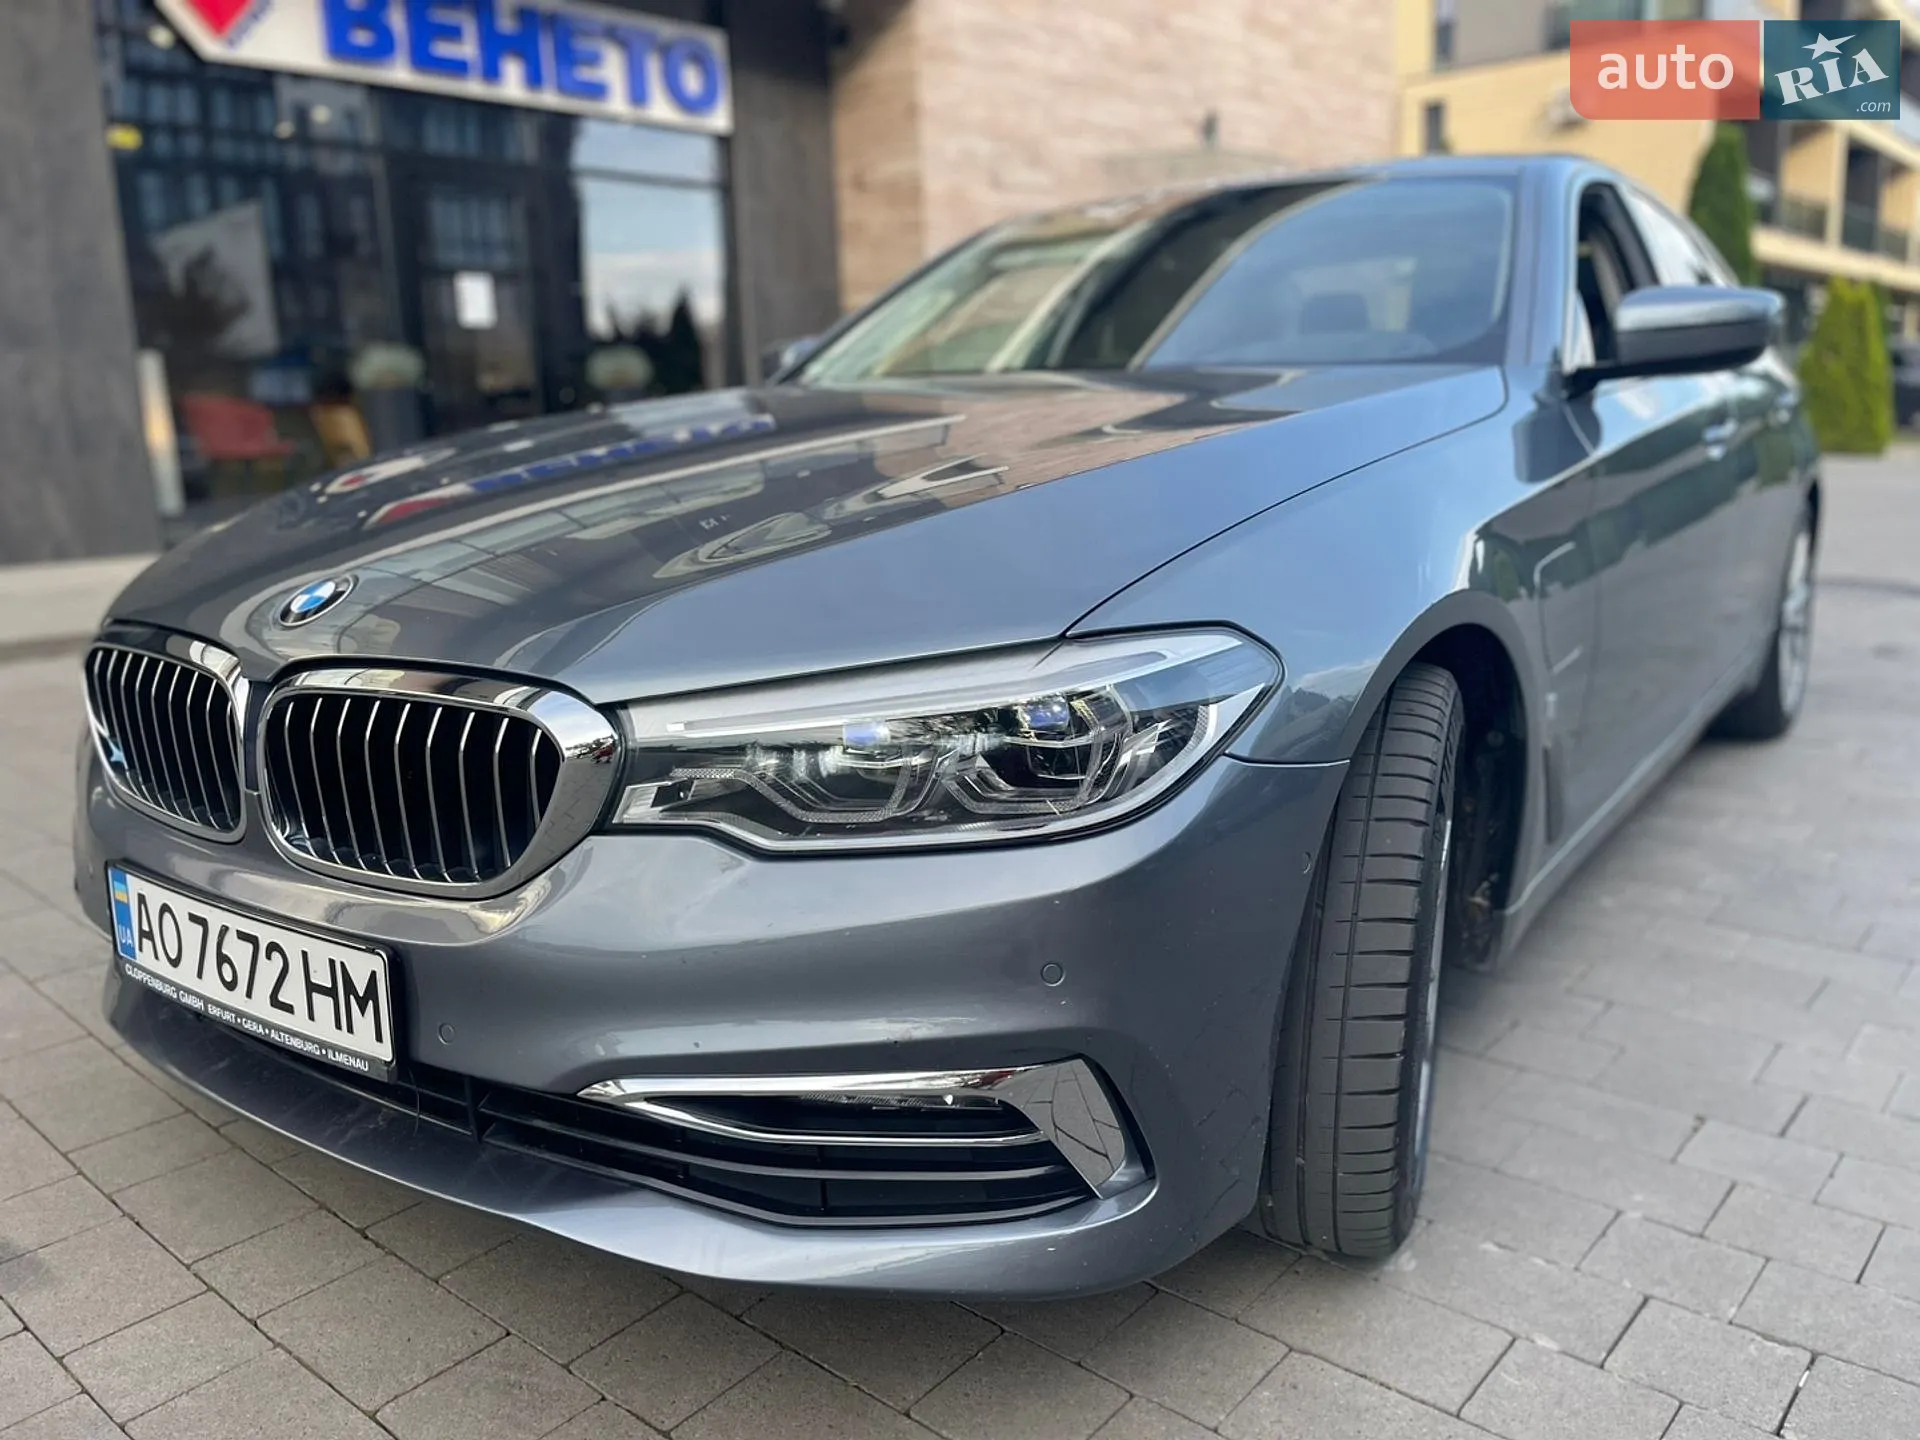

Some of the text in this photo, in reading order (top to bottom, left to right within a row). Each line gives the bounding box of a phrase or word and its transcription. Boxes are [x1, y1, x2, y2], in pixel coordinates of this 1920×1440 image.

[118, 926, 133, 946] UA
[207, 1003, 237, 1024] ERFURT
[242, 1017, 265, 1036] GERA
[270, 1029, 321, 1056] ALTENBURG
[327, 1048, 369, 1073] ILMENAU
